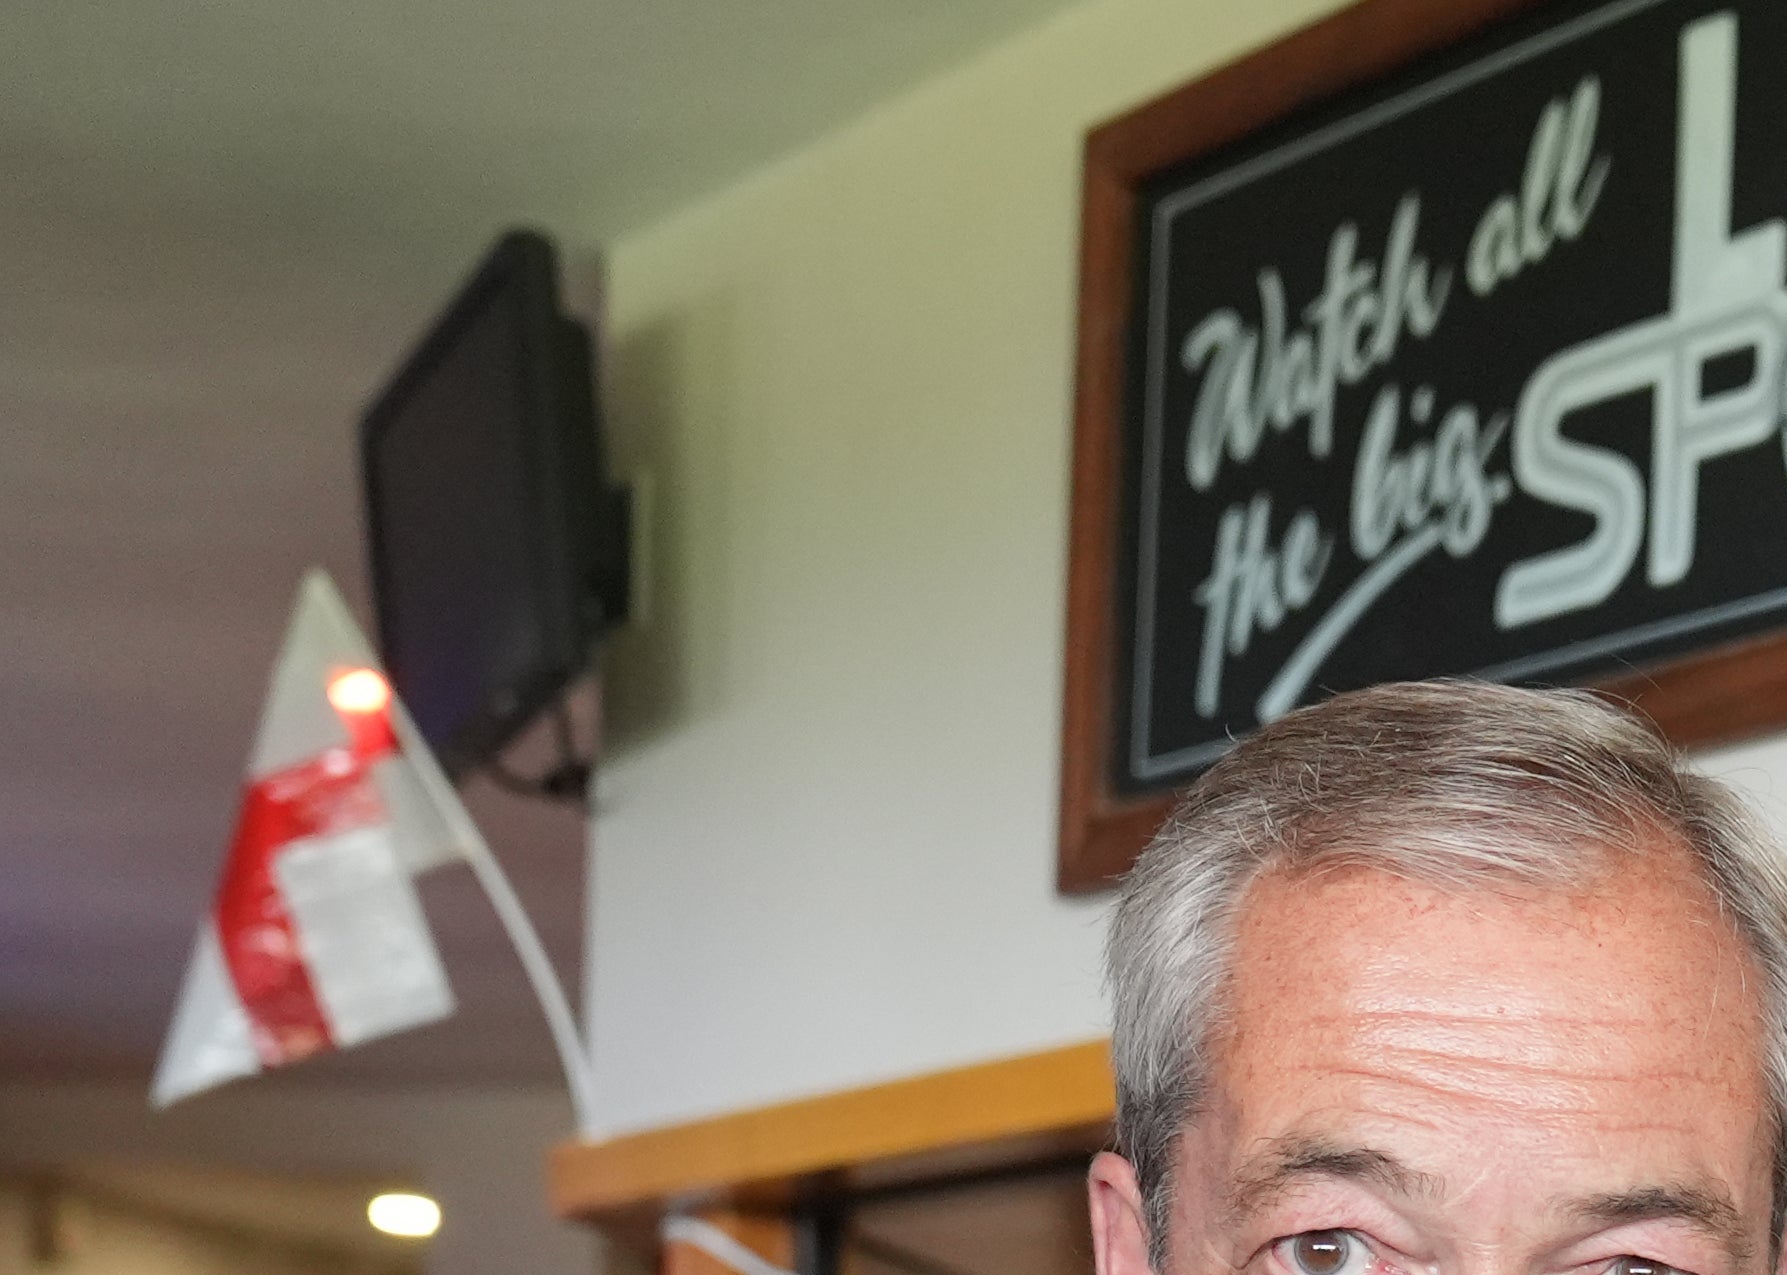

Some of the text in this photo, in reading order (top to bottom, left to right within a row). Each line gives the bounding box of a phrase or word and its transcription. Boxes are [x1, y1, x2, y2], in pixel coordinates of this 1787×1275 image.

[1181, 75, 1611, 492] Watch all
[1191, 491, 1336, 720] the
